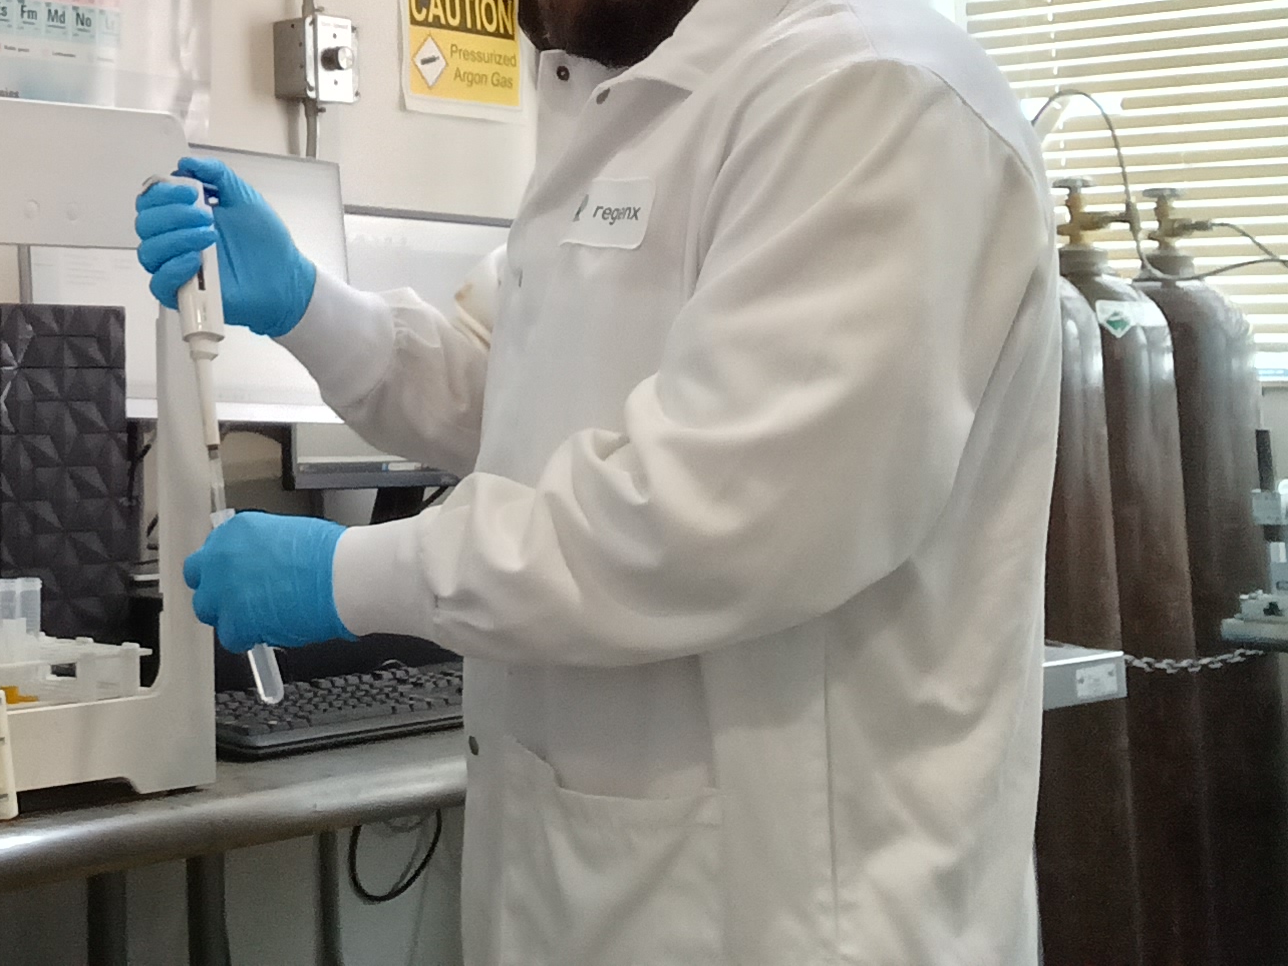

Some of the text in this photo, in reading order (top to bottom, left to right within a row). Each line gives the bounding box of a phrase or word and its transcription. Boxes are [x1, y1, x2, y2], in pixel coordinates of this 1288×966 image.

[20, 4, 38, 20] Fm
[47, 8, 66, 24] Md
[75, 12, 92, 28] No
[450, 44, 517, 68] Pressurized
[453, 67, 514, 89] Argon Gas
